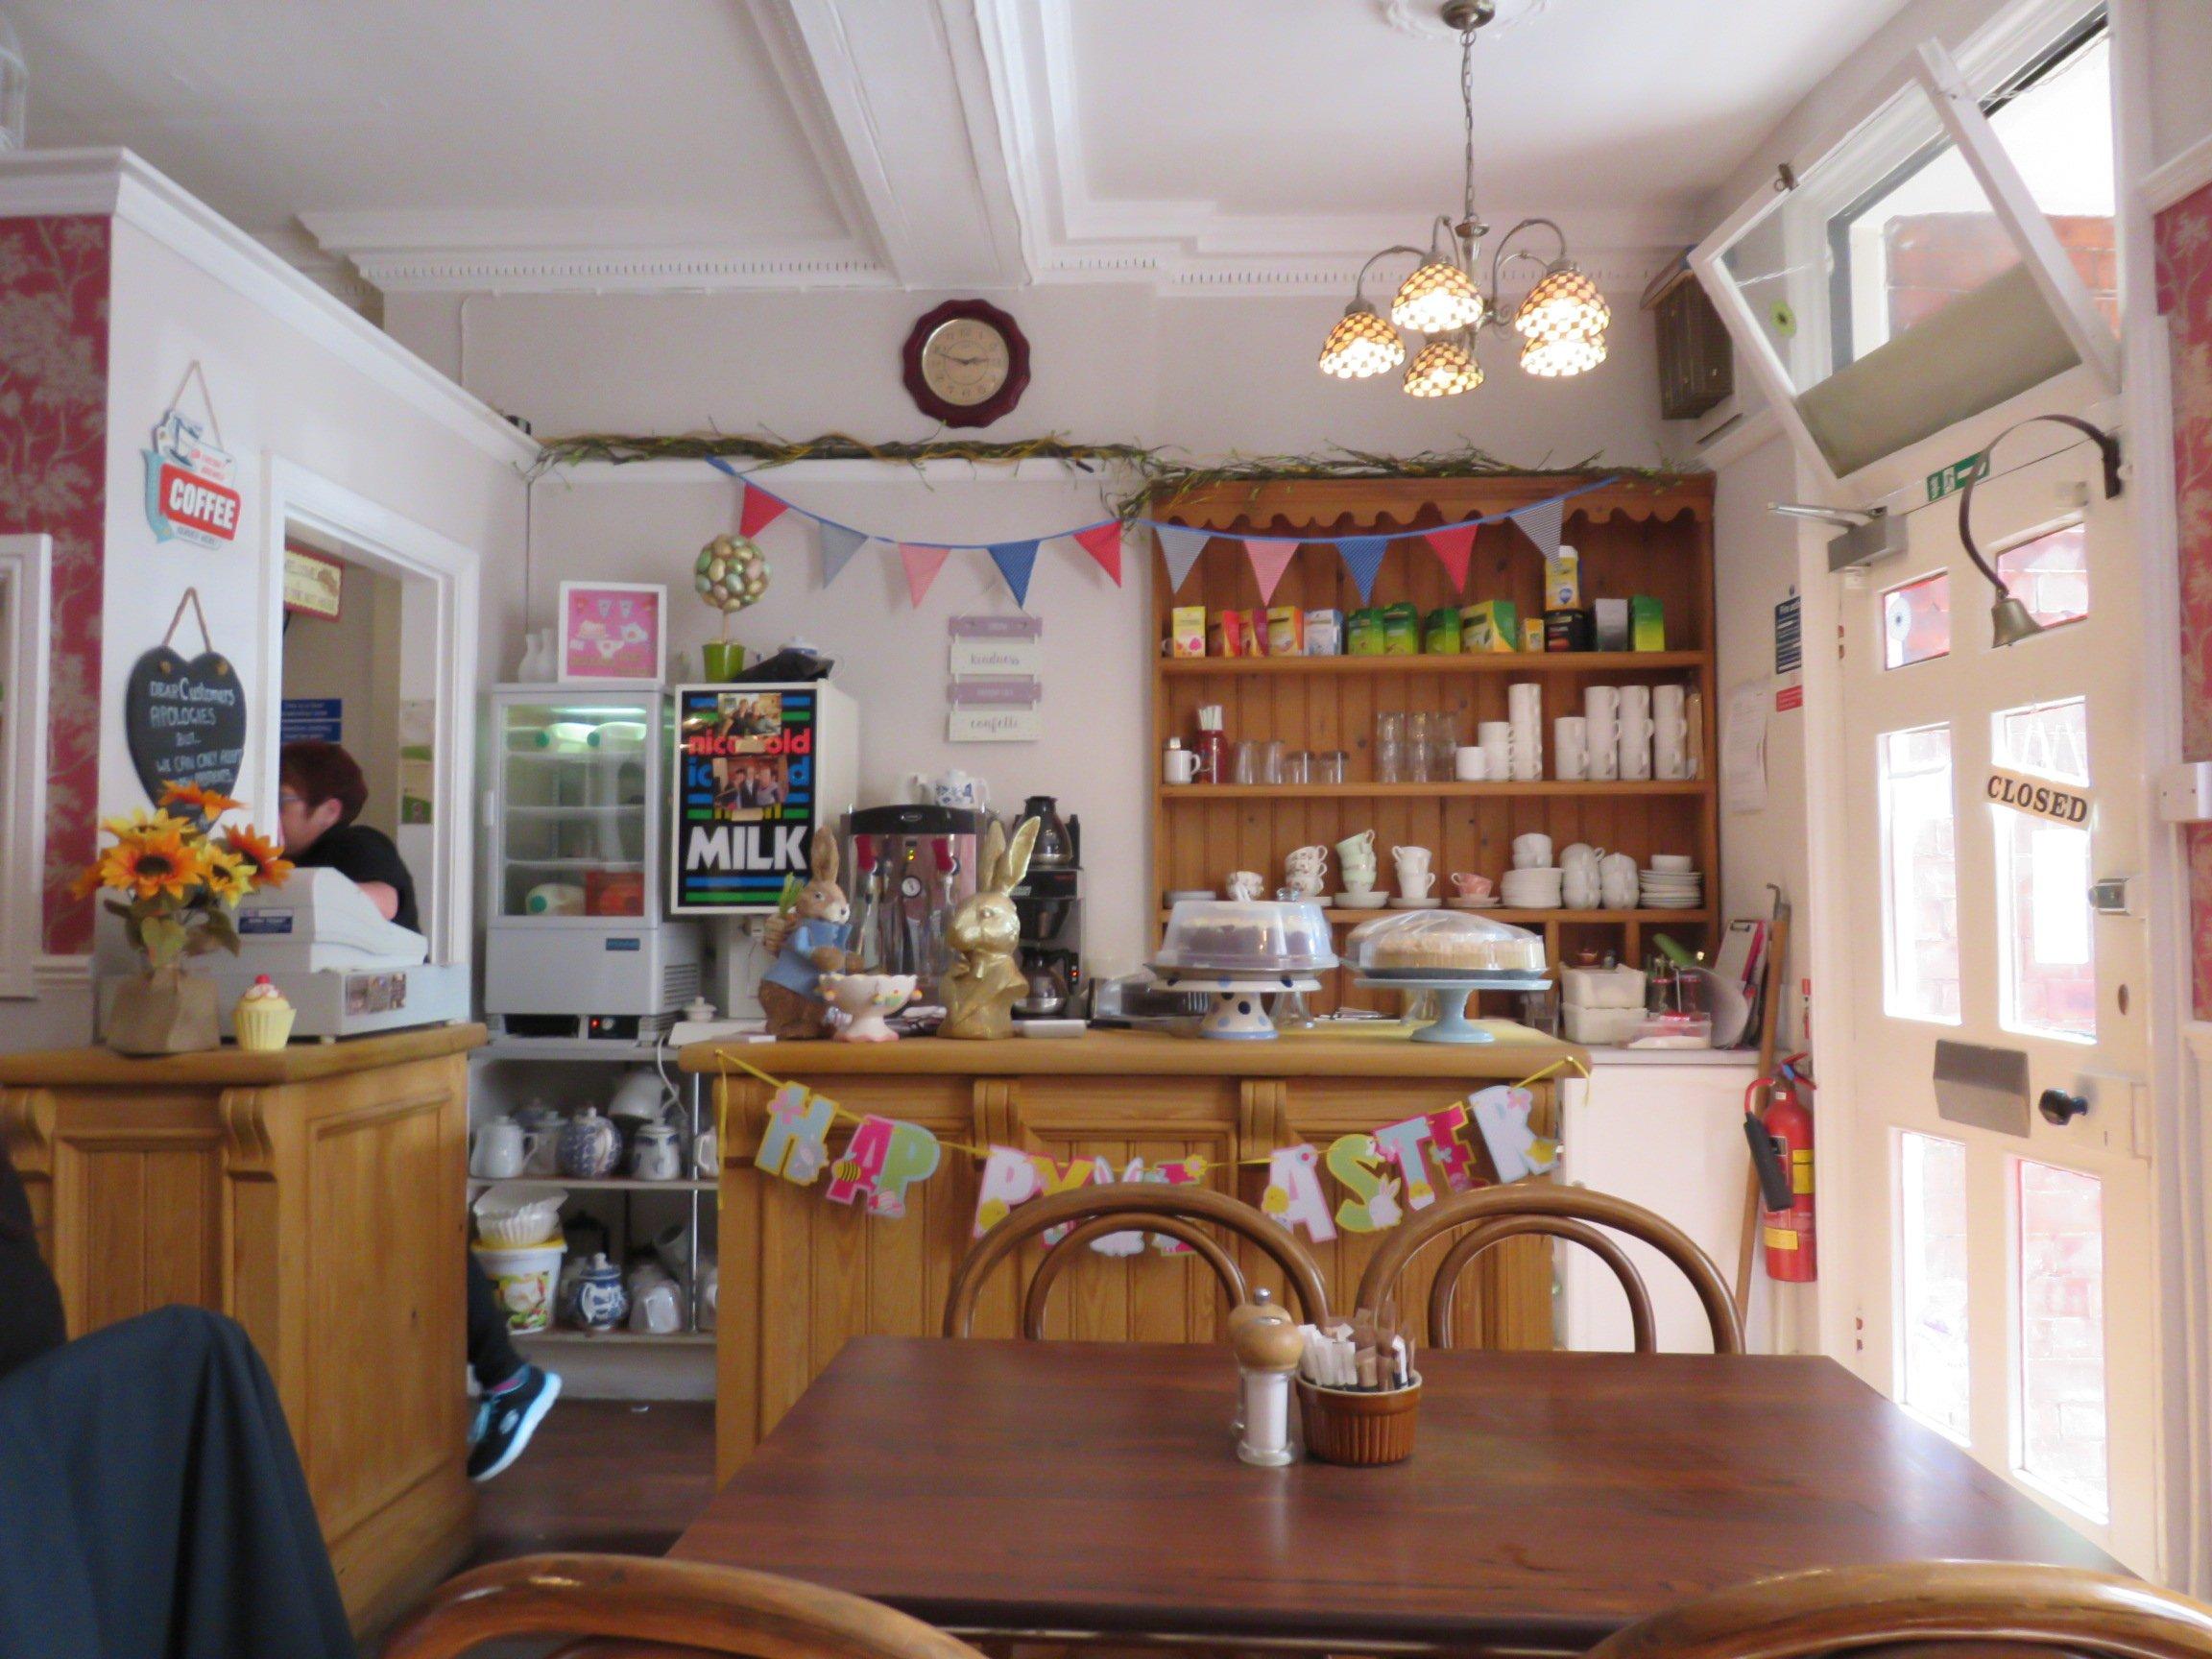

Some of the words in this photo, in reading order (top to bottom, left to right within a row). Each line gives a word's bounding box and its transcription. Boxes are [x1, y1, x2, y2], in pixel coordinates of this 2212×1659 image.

[169, 477, 236, 531] COFFEE
[150, 706, 217, 728] APOLOGIES
[1986, 774, 2088, 823] CLOSED
[685, 826, 808, 871] MILK
